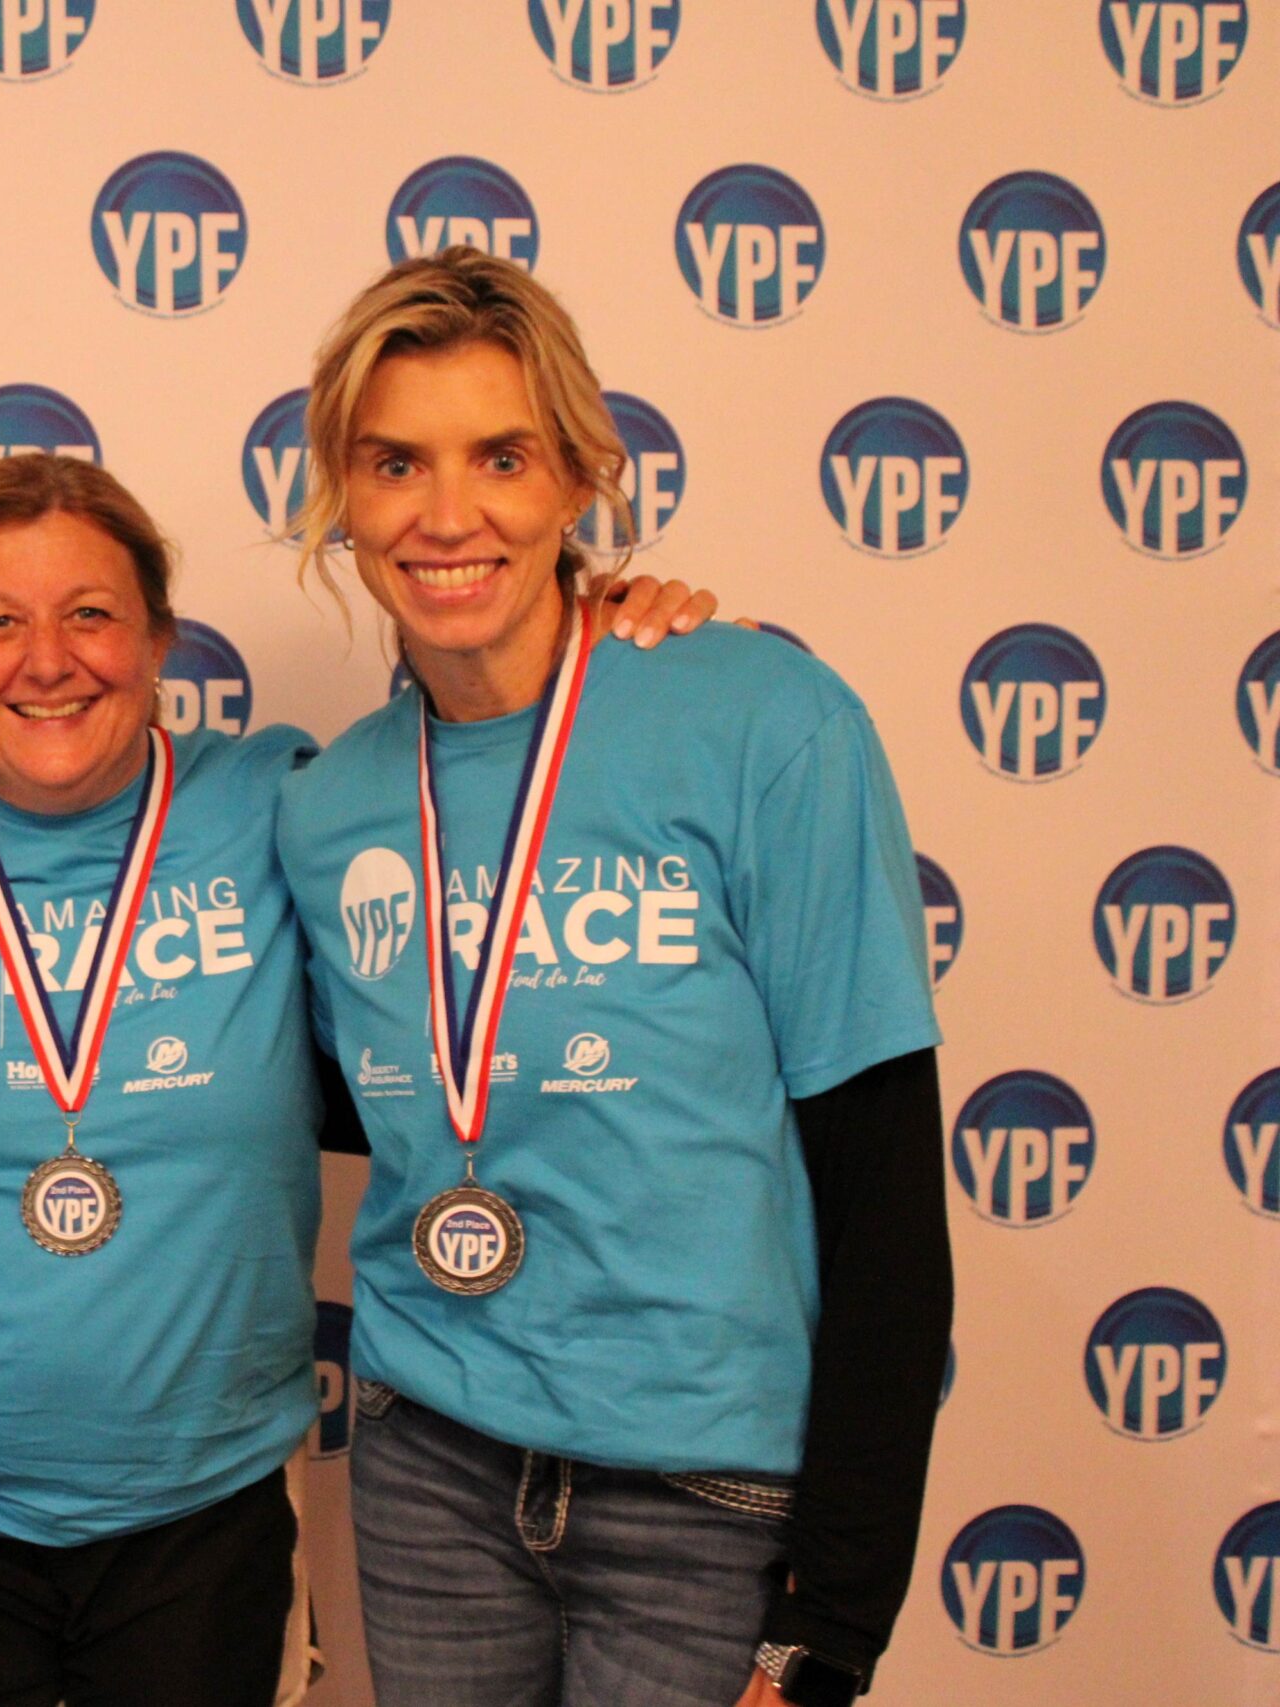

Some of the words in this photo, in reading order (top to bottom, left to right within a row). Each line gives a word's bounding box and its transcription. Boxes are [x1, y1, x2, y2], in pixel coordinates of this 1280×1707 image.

[248, 0, 381, 79] YPF
[540, 0, 670, 86] YPF
[827, 0, 956, 94] YPF
[1111, 4, 1241, 100] YPF
[101, 212, 239, 313] YPF
[686, 223, 817, 321] YPF
[970, 230, 1098, 328] YPF
[830, 456, 961, 552] YPF
[1112, 459, 1240, 554] YPF
[971, 681, 1099, 775] YPF
[346, 890, 410, 978] YPF
[1103, 904, 1230, 998] YPF
[123, 1071, 215, 1094] MERCURY
[541, 1077, 639, 1093] MERCURY
[45, 1198, 97, 1234] YPF
[962, 1127, 1089, 1220] YPF
[441, 1232, 497, 1271] YPF
[447, 1220, 463, 1229] 2nd
[465, 1220, 491, 1230] Place
[1094, 1342, 1220, 1435] YPF
[951, 1559, 1079, 1650] YPF
